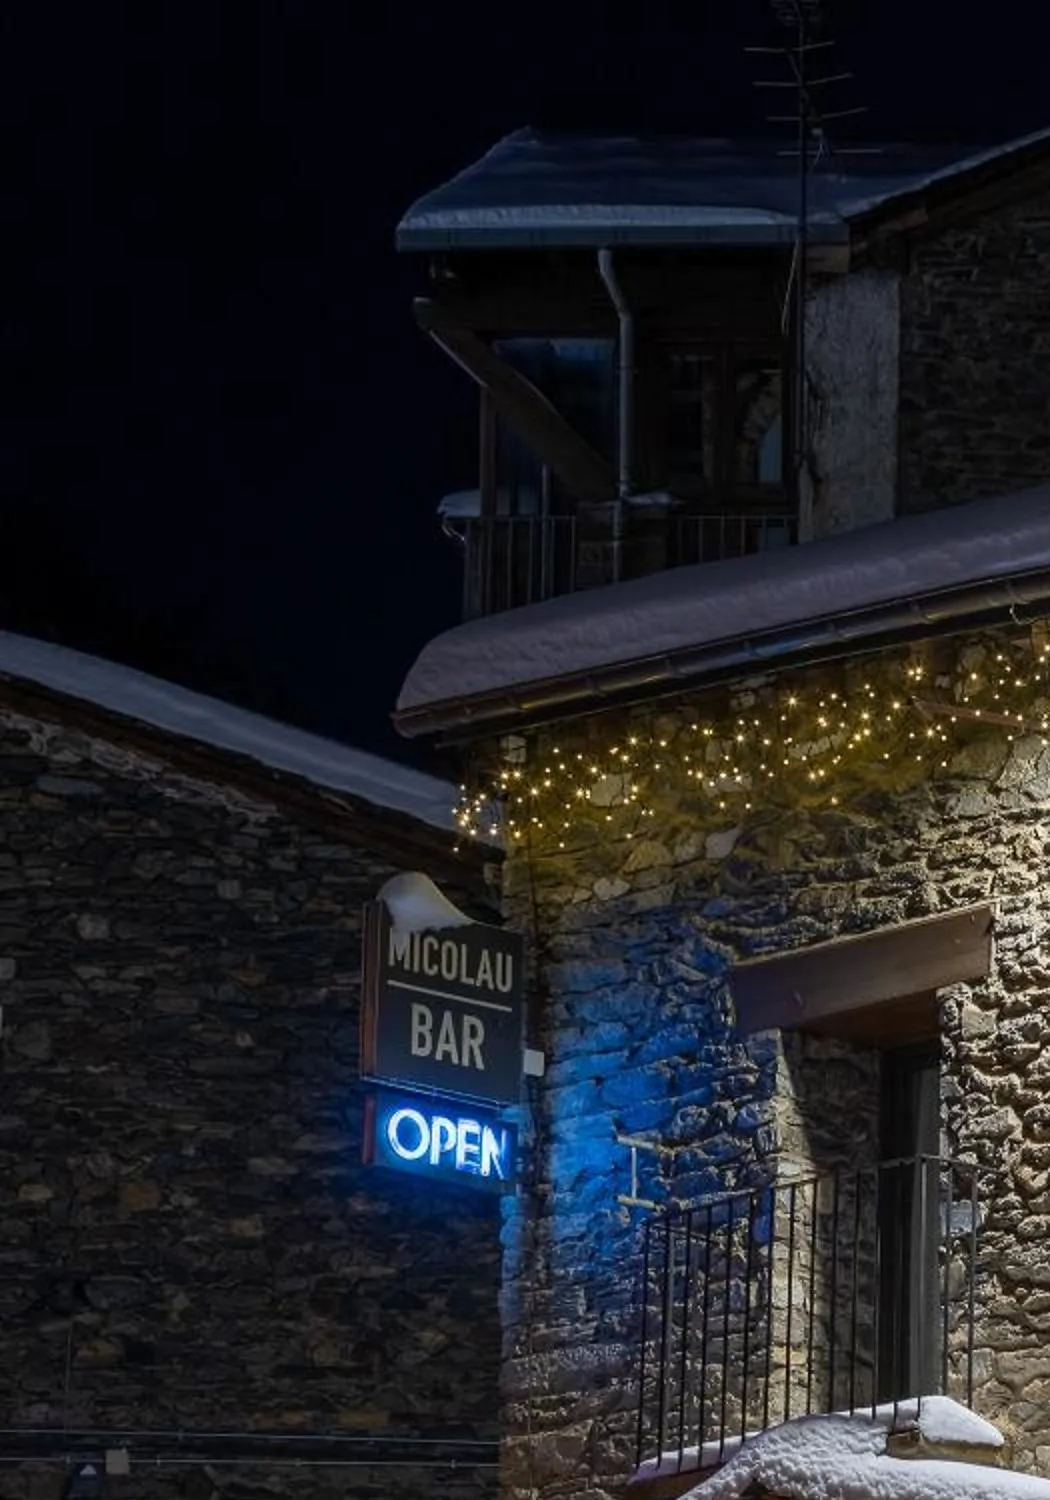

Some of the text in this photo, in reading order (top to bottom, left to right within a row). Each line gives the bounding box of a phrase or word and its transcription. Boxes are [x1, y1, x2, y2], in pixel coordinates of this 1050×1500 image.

[387, 927, 514, 993] MICOLAU
[411, 1002, 485, 1071] BAR
[387, 1108, 507, 1180] OPEN
